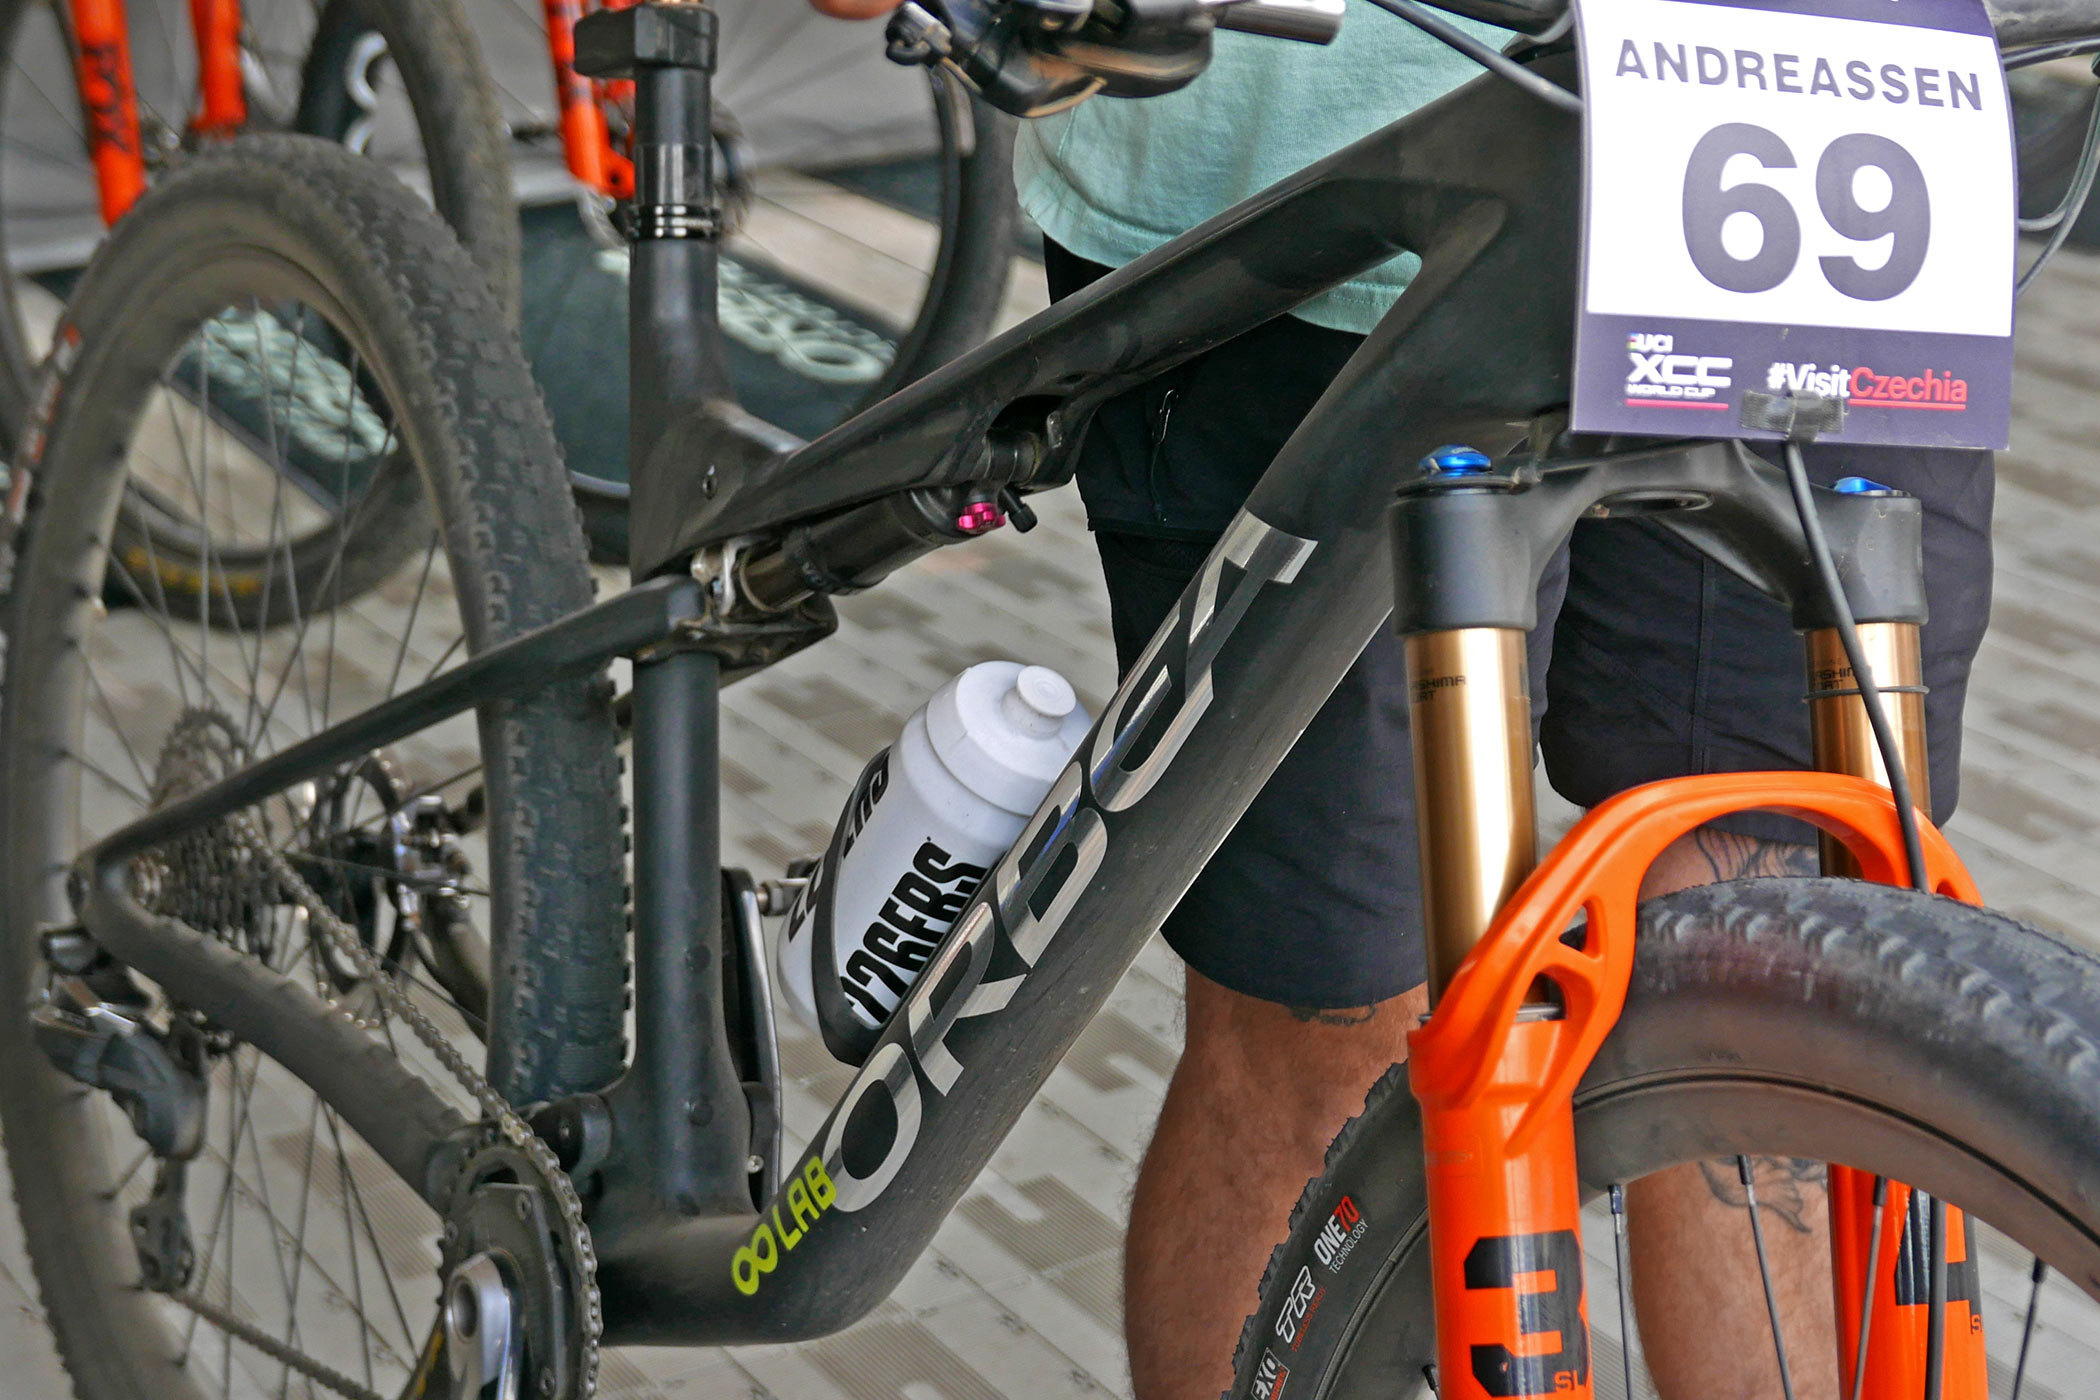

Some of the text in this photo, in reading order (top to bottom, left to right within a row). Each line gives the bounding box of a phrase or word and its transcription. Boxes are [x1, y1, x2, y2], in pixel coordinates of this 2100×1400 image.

[1615, 39, 1983, 111] ANDREASSEN
[1681, 122, 1932, 302] 69
[1626, 352, 1734, 388] XCC
[1637, 332, 1674, 353] UCI
[1625, 384, 1717, 400] WORLD CUP
[1766, 361, 1968, 402] #VisitCzechia
[824, 506, 1319, 1212] ORBEA
[1313, 1195, 1360, 1265] ONE70
[1328, 1218, 1369, 1274] TECHNOLOGY
[1275, 1265, 1316, 1344] TR
